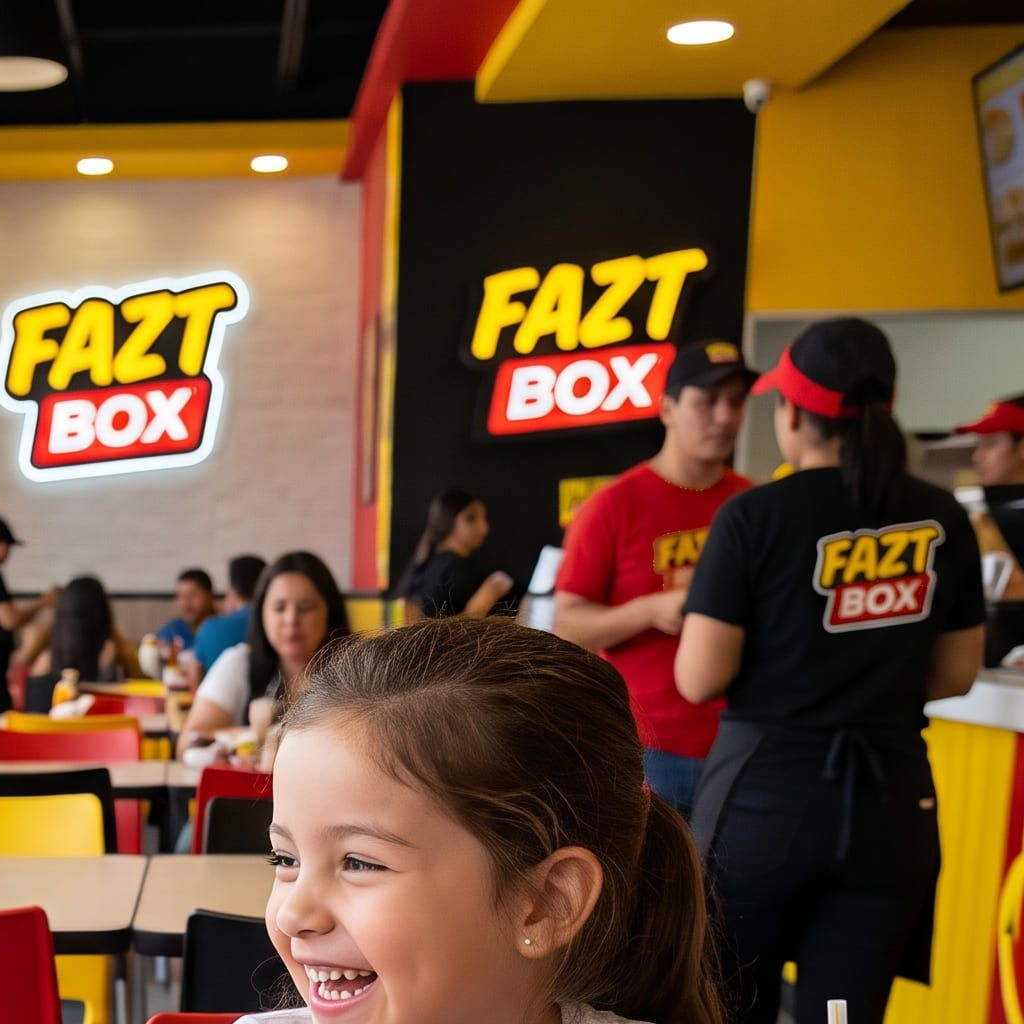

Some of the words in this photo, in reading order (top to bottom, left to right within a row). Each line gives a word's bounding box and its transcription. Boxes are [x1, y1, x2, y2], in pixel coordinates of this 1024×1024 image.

[471, 248, 708, 360] FAZT
[7, 283, 236, 396] FAZT
[48, 387, 192, 454] BOX
[506, 353, 659, 421] BOX
[820, 527, 938, 588] FAZT
[839, 579, 921, 619] BOX
